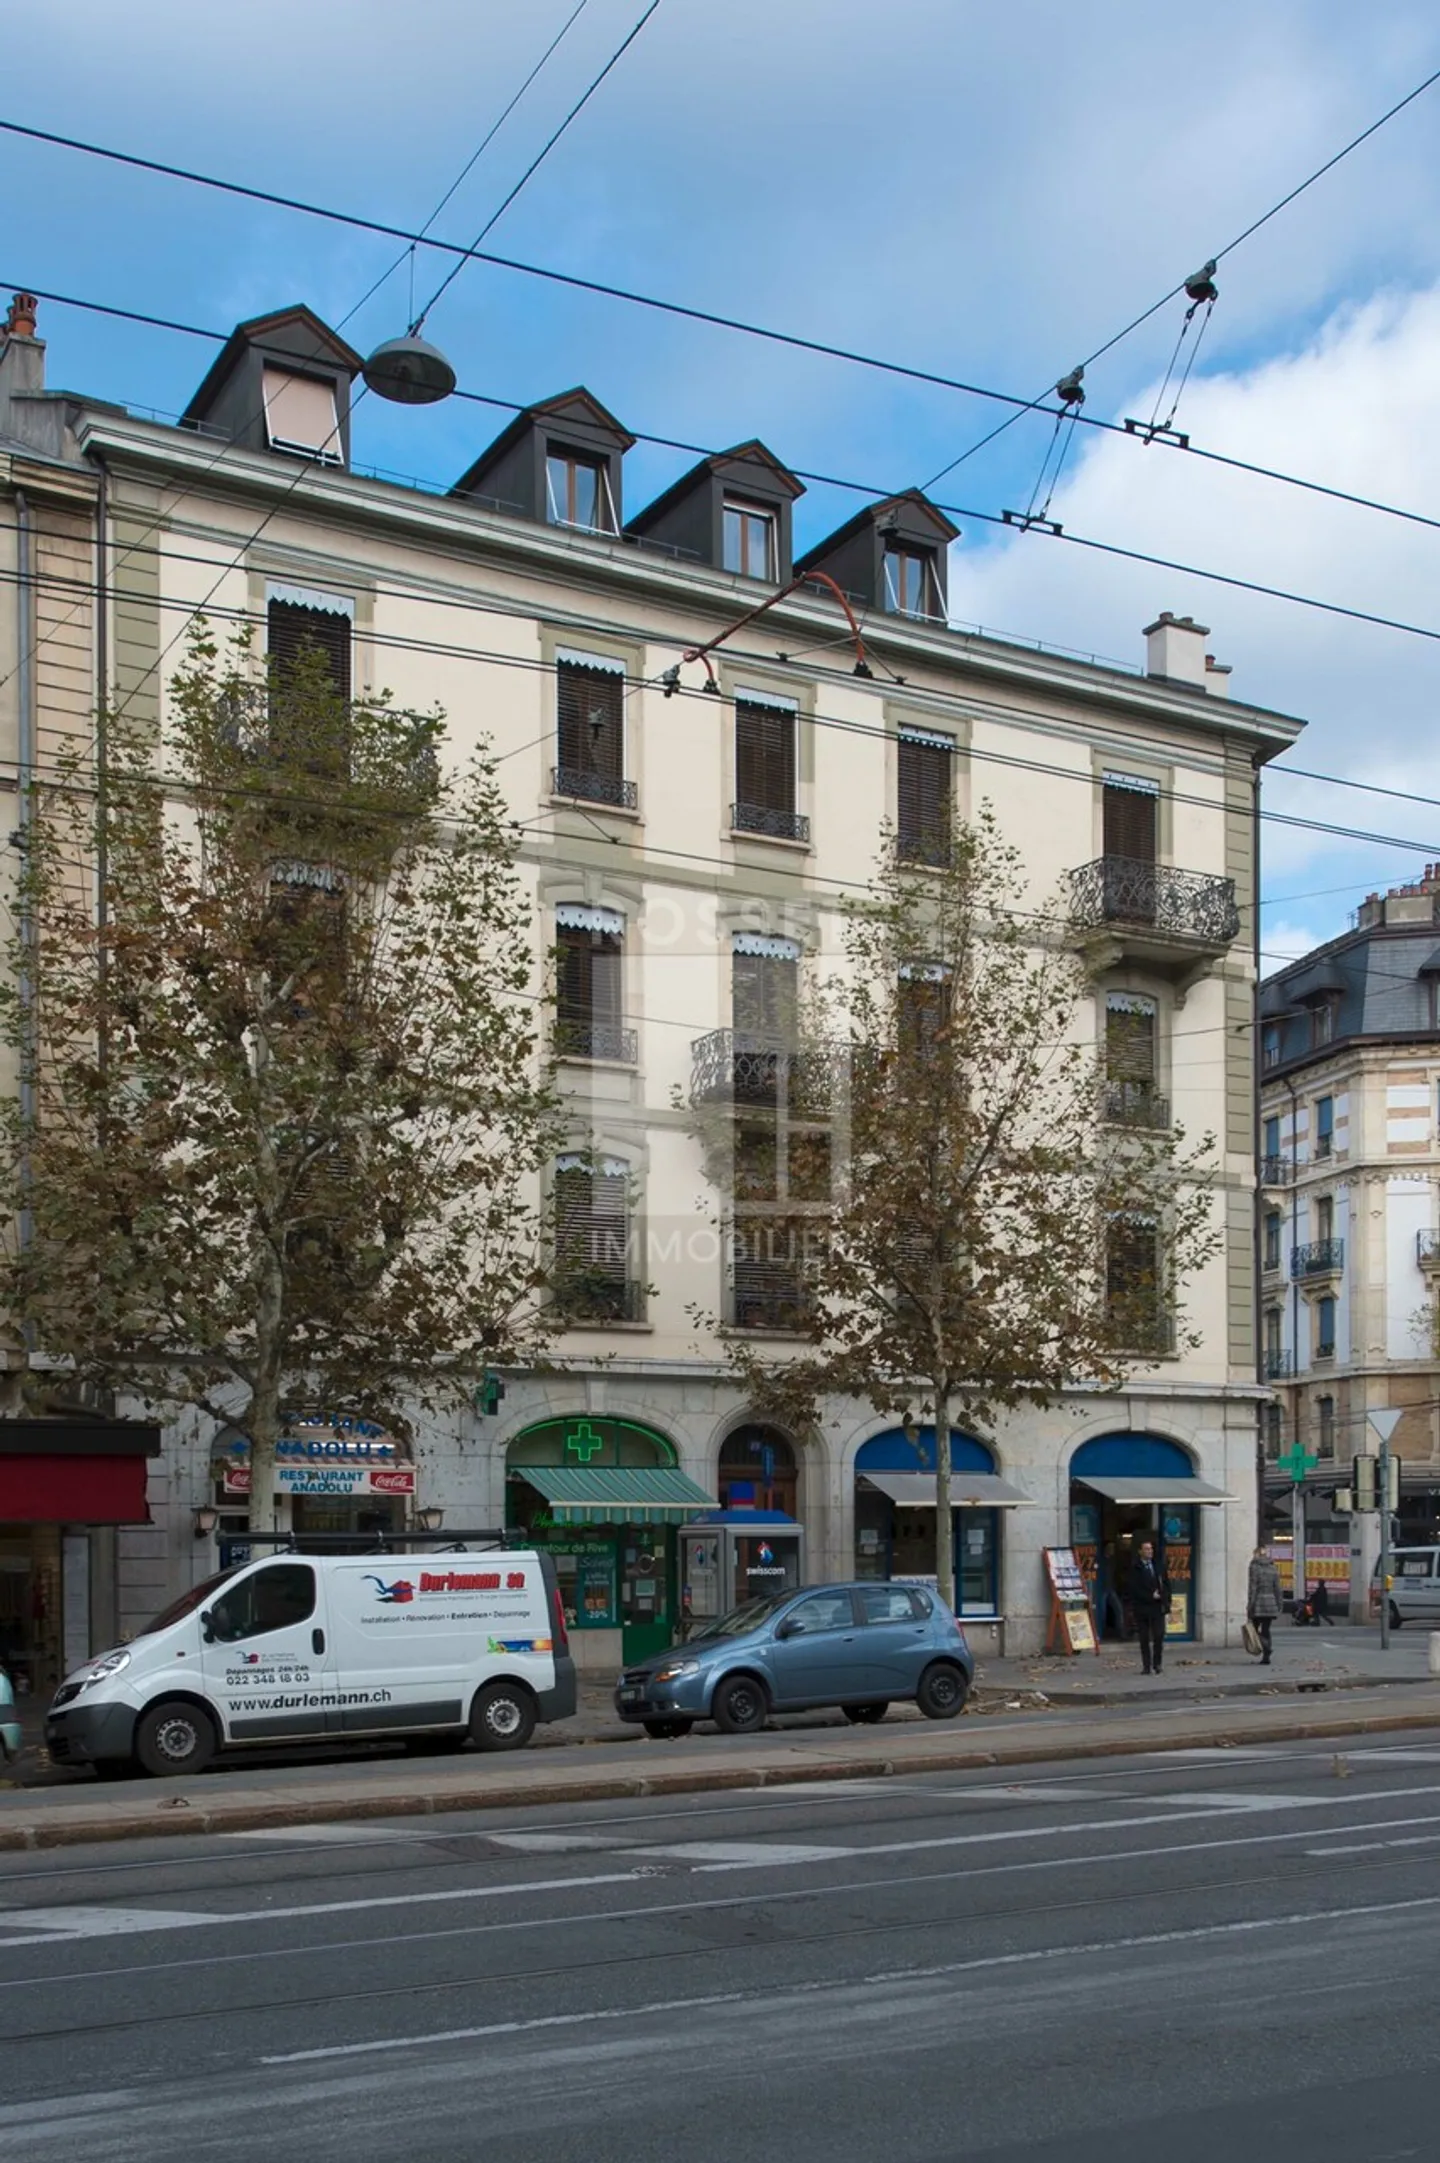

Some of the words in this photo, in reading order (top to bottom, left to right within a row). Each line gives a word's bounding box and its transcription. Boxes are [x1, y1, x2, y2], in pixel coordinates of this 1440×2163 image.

[276, 1440, 370, 1457] NADOLU
[279, 1470, 364, 1482] RESTAURANT
[291, 1482, 353, 1494] ANADOLU
[745, 1565, 786, 1577] swisscom
[419, 1572, 501, 1592] Durlemann
[361, 1615, 401, 1624] Installation
[406, 1612, 446, 1622] Rénovation
[451, 1611, 488, 1621] Entretien
[493, 1609, 531, 1620] Dépannage
[226, 1675, 249, 1686] 022
[253, 1675, 276, 1685] 348
[279, 1673, 292, 1684] 18
[295, 1673, 310, 1683] 03
[228, 1689, 392, 1711] www.durlemann.ch
